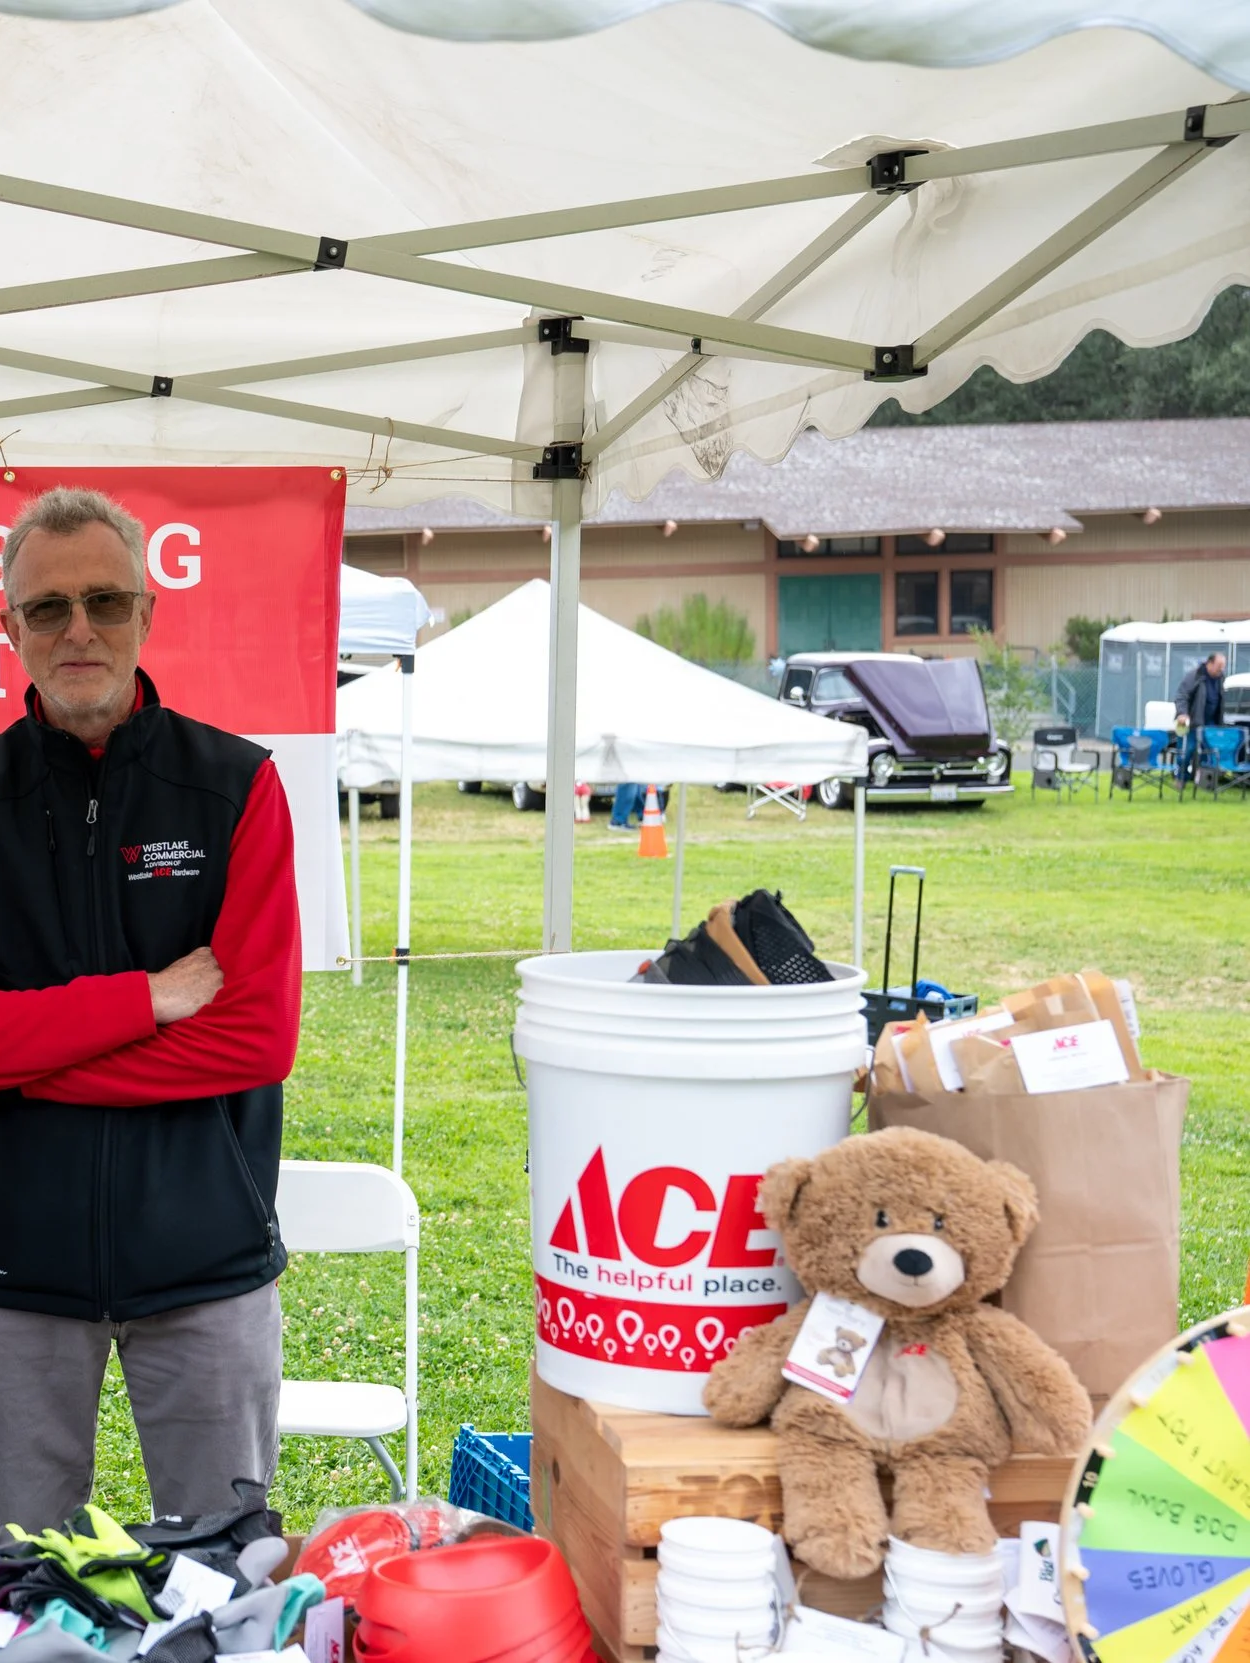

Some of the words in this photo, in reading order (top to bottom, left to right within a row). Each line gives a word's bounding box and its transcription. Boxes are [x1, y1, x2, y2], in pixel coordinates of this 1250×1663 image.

[142, 841, 189, 853] WESTLAKE
[143, 849, 206, 862] COMMERCIAL
[128, 872, 153, 881] Westlake
[153, 867, 172, 877] ACE
[149, 860, 173, 869] DIVISION
[173, 859, 182, 867] OF
[549, 1144, 778, 1268] ACE
[552, 1252, 589, 1279] The
[597, 1264, 693, 1292] helpful
[703, 1274, 782, 1297] place.
[1082, 1471, 1099, 1489] 10
[1127, 1488, 1186, 1526] BOWL
[1192, 1513, 1238, 1543] DOG
[1127, 1560, 1215, 1590] GLOVES
[1169, 1600, 1209, 1635] HAT
